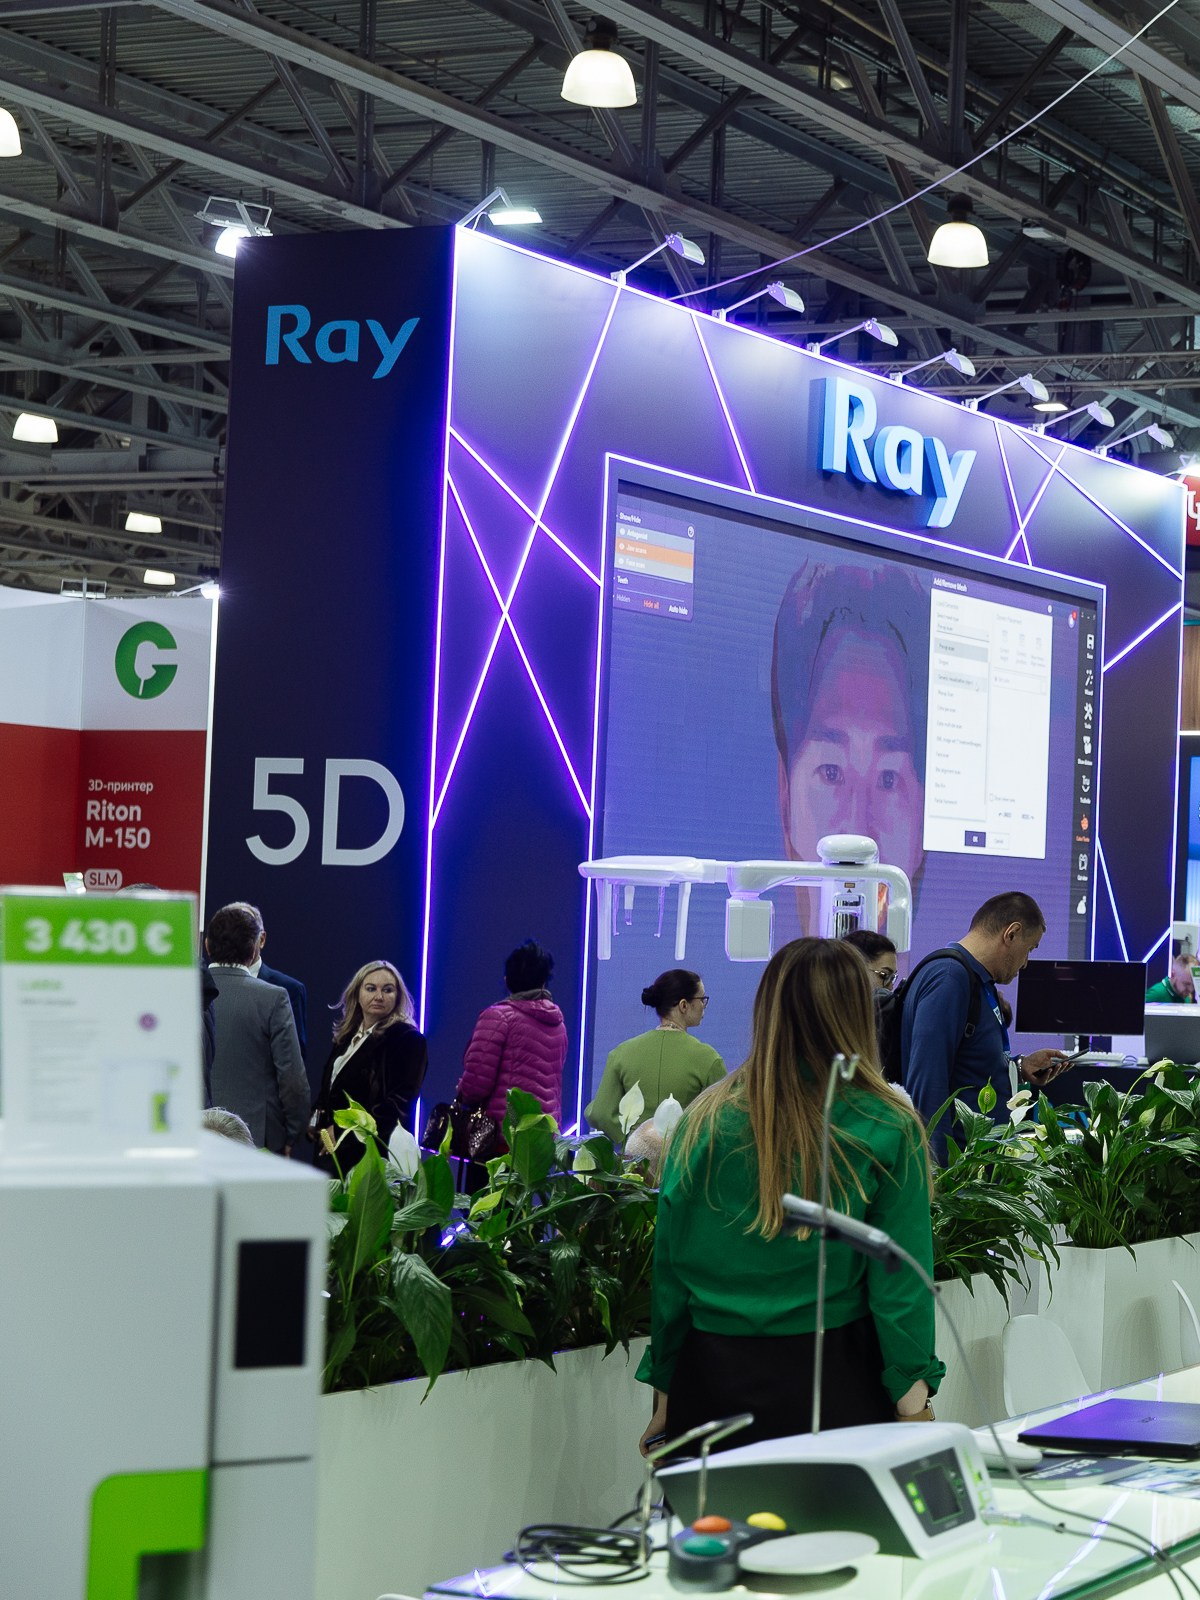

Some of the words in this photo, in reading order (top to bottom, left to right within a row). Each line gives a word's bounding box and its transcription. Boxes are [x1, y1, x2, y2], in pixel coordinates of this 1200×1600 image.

[265, 304, 421, 379] Ray
[823, 376, 977, 528] Ray
[88, 779, 154, 794] 3D-принтер
[86, 799, 142, 822] Riton
[245, 757, 405, 866] 5D
[85, 827, 151, 849] M-150
[89, 872, 118, 886] SLM
[24, 916, 53, 953] 3
[59, 919, 137, 955] 430
[143, 921, 174, 955] €
